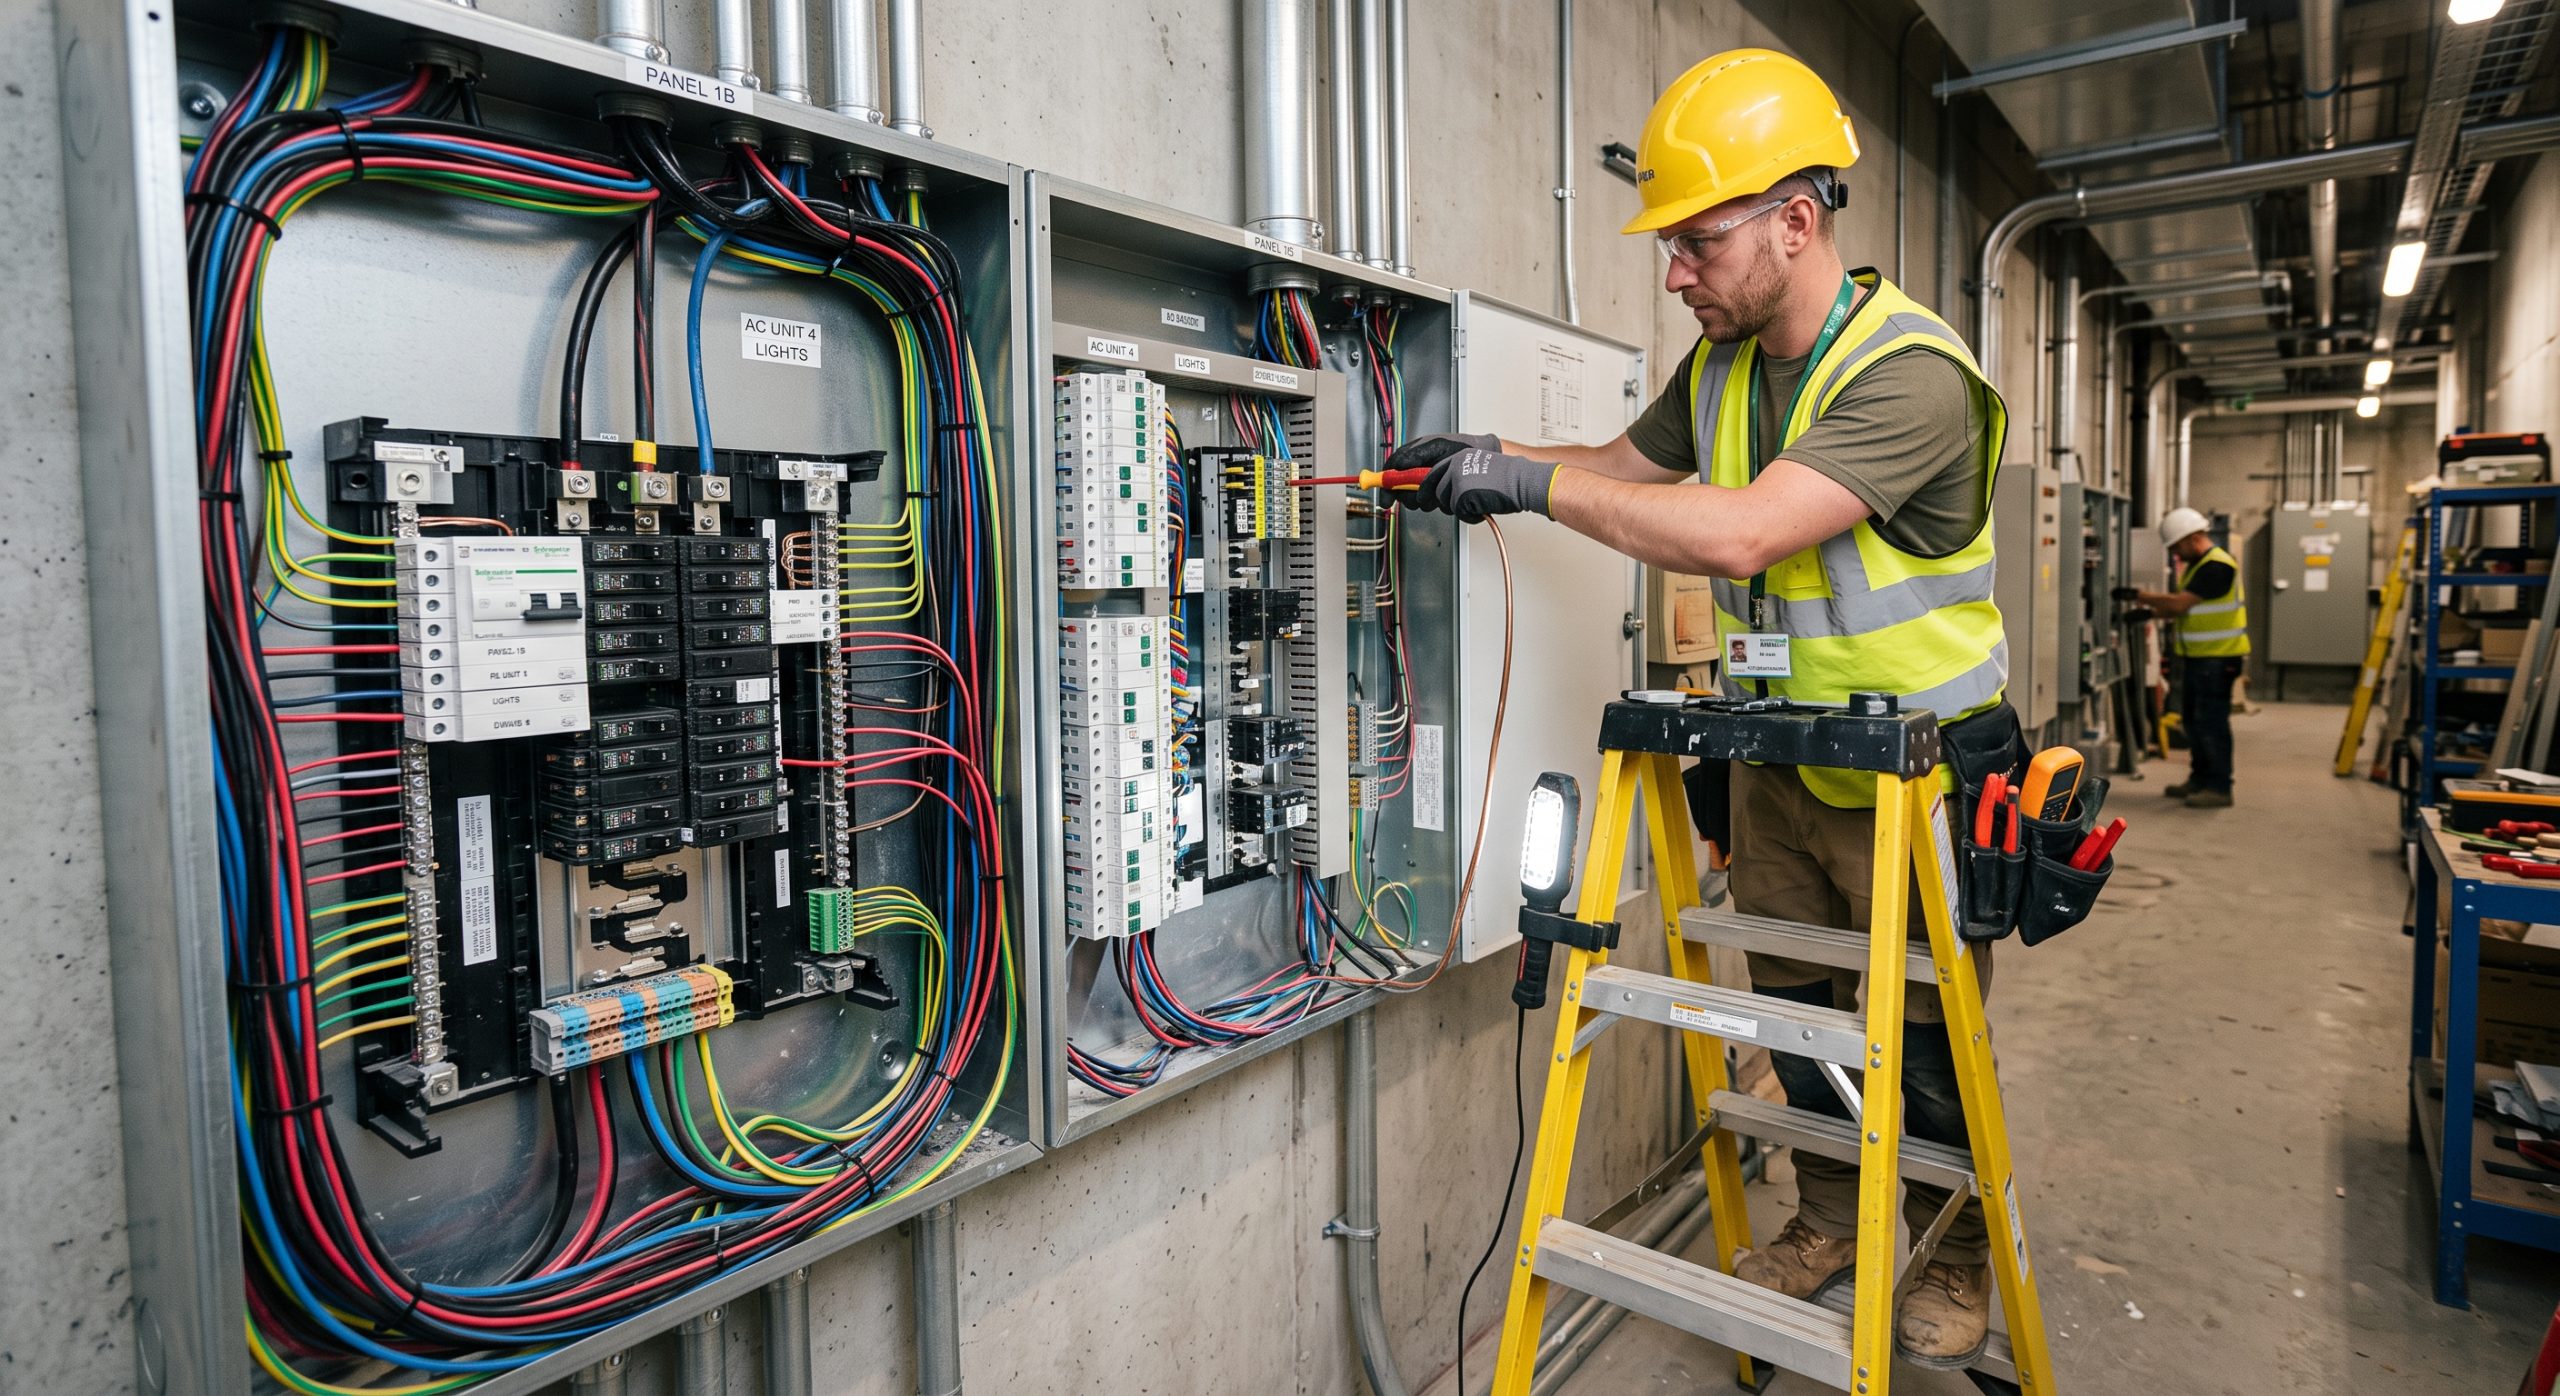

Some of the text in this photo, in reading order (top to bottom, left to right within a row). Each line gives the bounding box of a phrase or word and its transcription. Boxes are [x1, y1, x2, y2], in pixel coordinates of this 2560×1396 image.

[645, 66, 735, 104] PANEL 1B
[1254, 236, 1281, 254] PANEL
[745, 318, 816, 340] AC UNIT 4
[756, 342, 808, 361] LIGHTS
[1091, 341, 1134, 357] AC UNIT 4
[1178, 358, 1206, 371] LIGHTS
